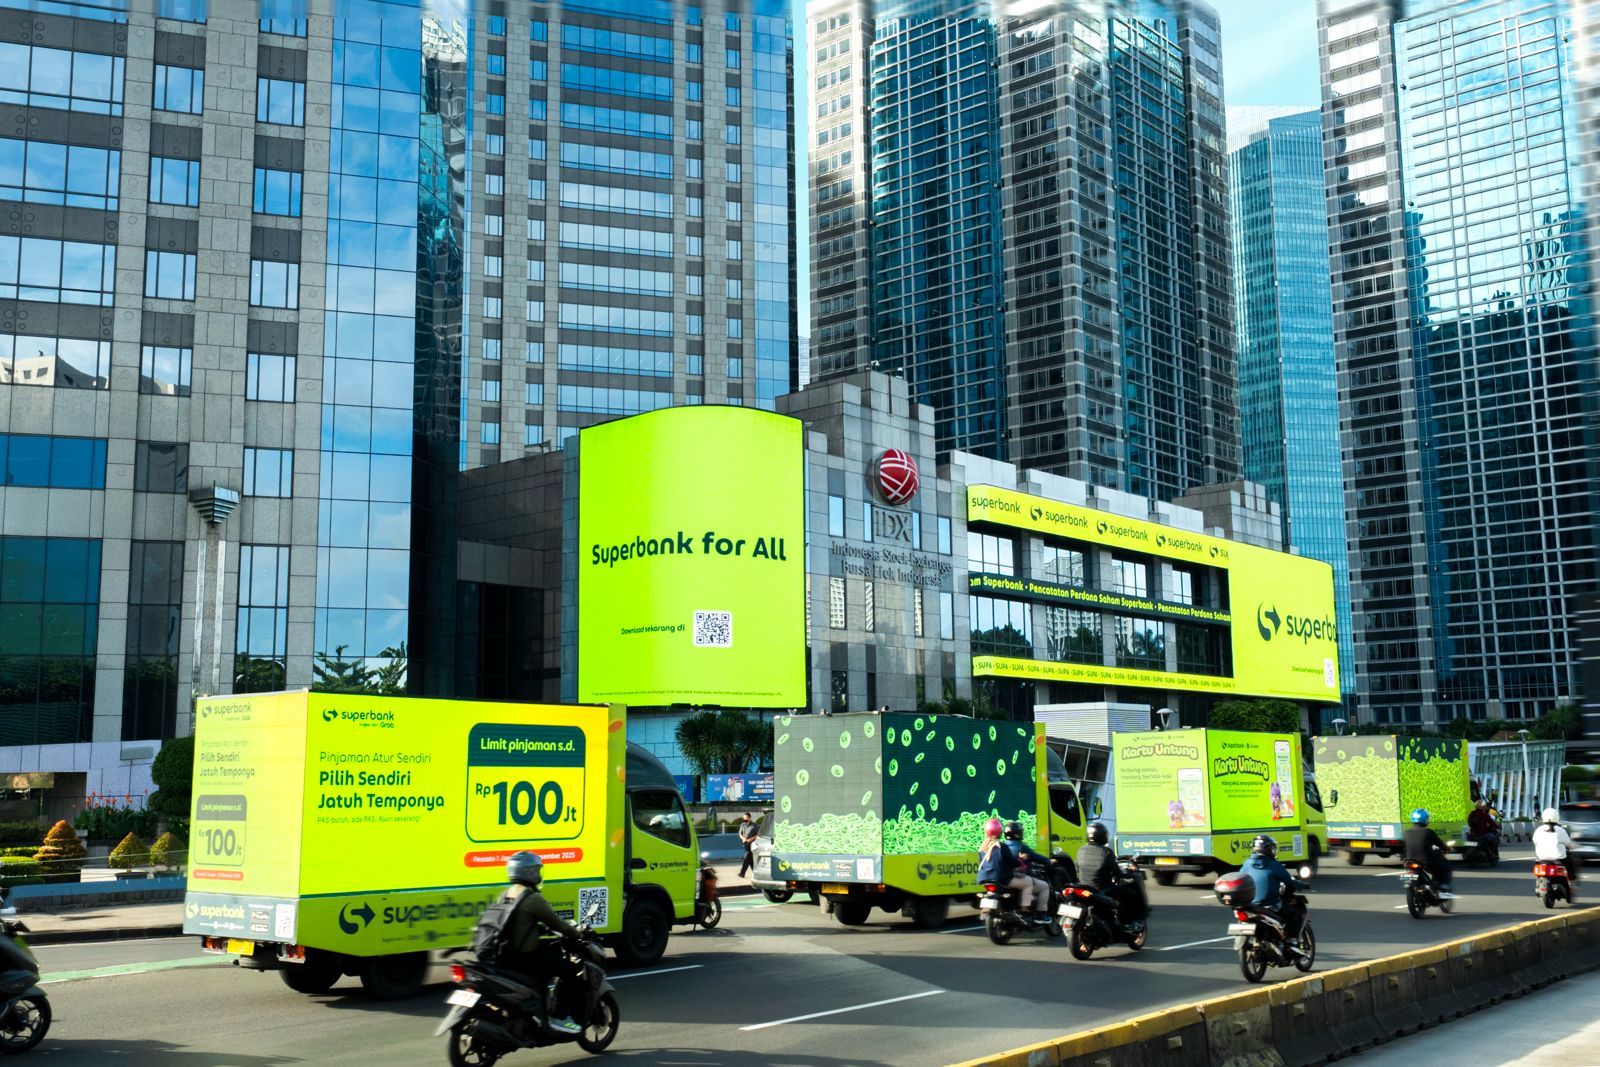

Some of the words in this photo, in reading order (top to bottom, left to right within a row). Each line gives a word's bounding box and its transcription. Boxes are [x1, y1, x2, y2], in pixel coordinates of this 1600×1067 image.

[972, 497, 1020, 514] superbank
[875, 510, 911, 543] IDX
[1045, 511, 1088, 528] superbank
[1110, 525, 1148, 541] superbank
[592, 531, 694, 568] Superbank
[702, 531, 746, 556] for
[752, 537, 787, 561] All
[1168, 537, 1203, 553] superbank
[831, 540, 879, 561] Indonesia
[883, 548, 907, 566] Stock
[910, 552, 952, 575] Exchange
[841, 560, 870, 577] Bursa
[873, 564, 894, 583] Efek
[897, 568, 942, 587] Indonesia
[983, 576, 1024, 591] Superbank
[1029, 583, 1070, 598] Pencatatan
[1070, 589, 1098, 603] Perdana
[1099, 594, 1121, 605] Saham
[1121, 597, 1154, 611] Superbank
[1158, 603, 1190, 616] Pencatatan
[1191, 608, 1213, 619] Perdana
[1214, 612, 1231, 622] Saham
[621, 626, 645, 635] Download
[645, 624, 676, 634] sekarang
[677, 623, 685, 632] di
[995, 662, 1009, 670] SUPA
[214, 702, 252, 717] superbank
[341, 709, 394, 722] superbank
[480, 737, 507, 750] Limit
[508, 738, 556, 753] pinjaman
[558, 740, 576, 752] s.d.
[1122, 744, 1155, 760] Kartu
[1154, 743, 1199, 760] Untung
[200, 753, 215, 762] Pilih
[216, 752, 240, 762] Sendiri
[320, 751, 370, 765] Pinjaman
[373, 752, 394, 763] Atur
[397, 753, 431, 764] Sendiri
[200, 767, 219, 777] Jatuh
[220, 767, 255, 778] Temponya
[1214, 757, 1239, 778] Kartu
[1238, 755, 1270, 781] Untung
[320, 770, 354, 786] Pilih
[358, 770, 411, 786] Sendiri
[318, 792, 363, 809] Jatuh
[367, 793, 445, 811] Temponya
[475, 783, 491, 798] Rp
[493, 780, 563, 825] 100
[563, 806, 577, 822] Jt
[205, 828, 236, 856] 100
[562, 851, 576, 859] 2025
[660, 859, 688, 868] superbank
[791, 861, 830, 871] superbank
[937, 859, 979, 878] superba
[200, 904, 245, 919] superbank
